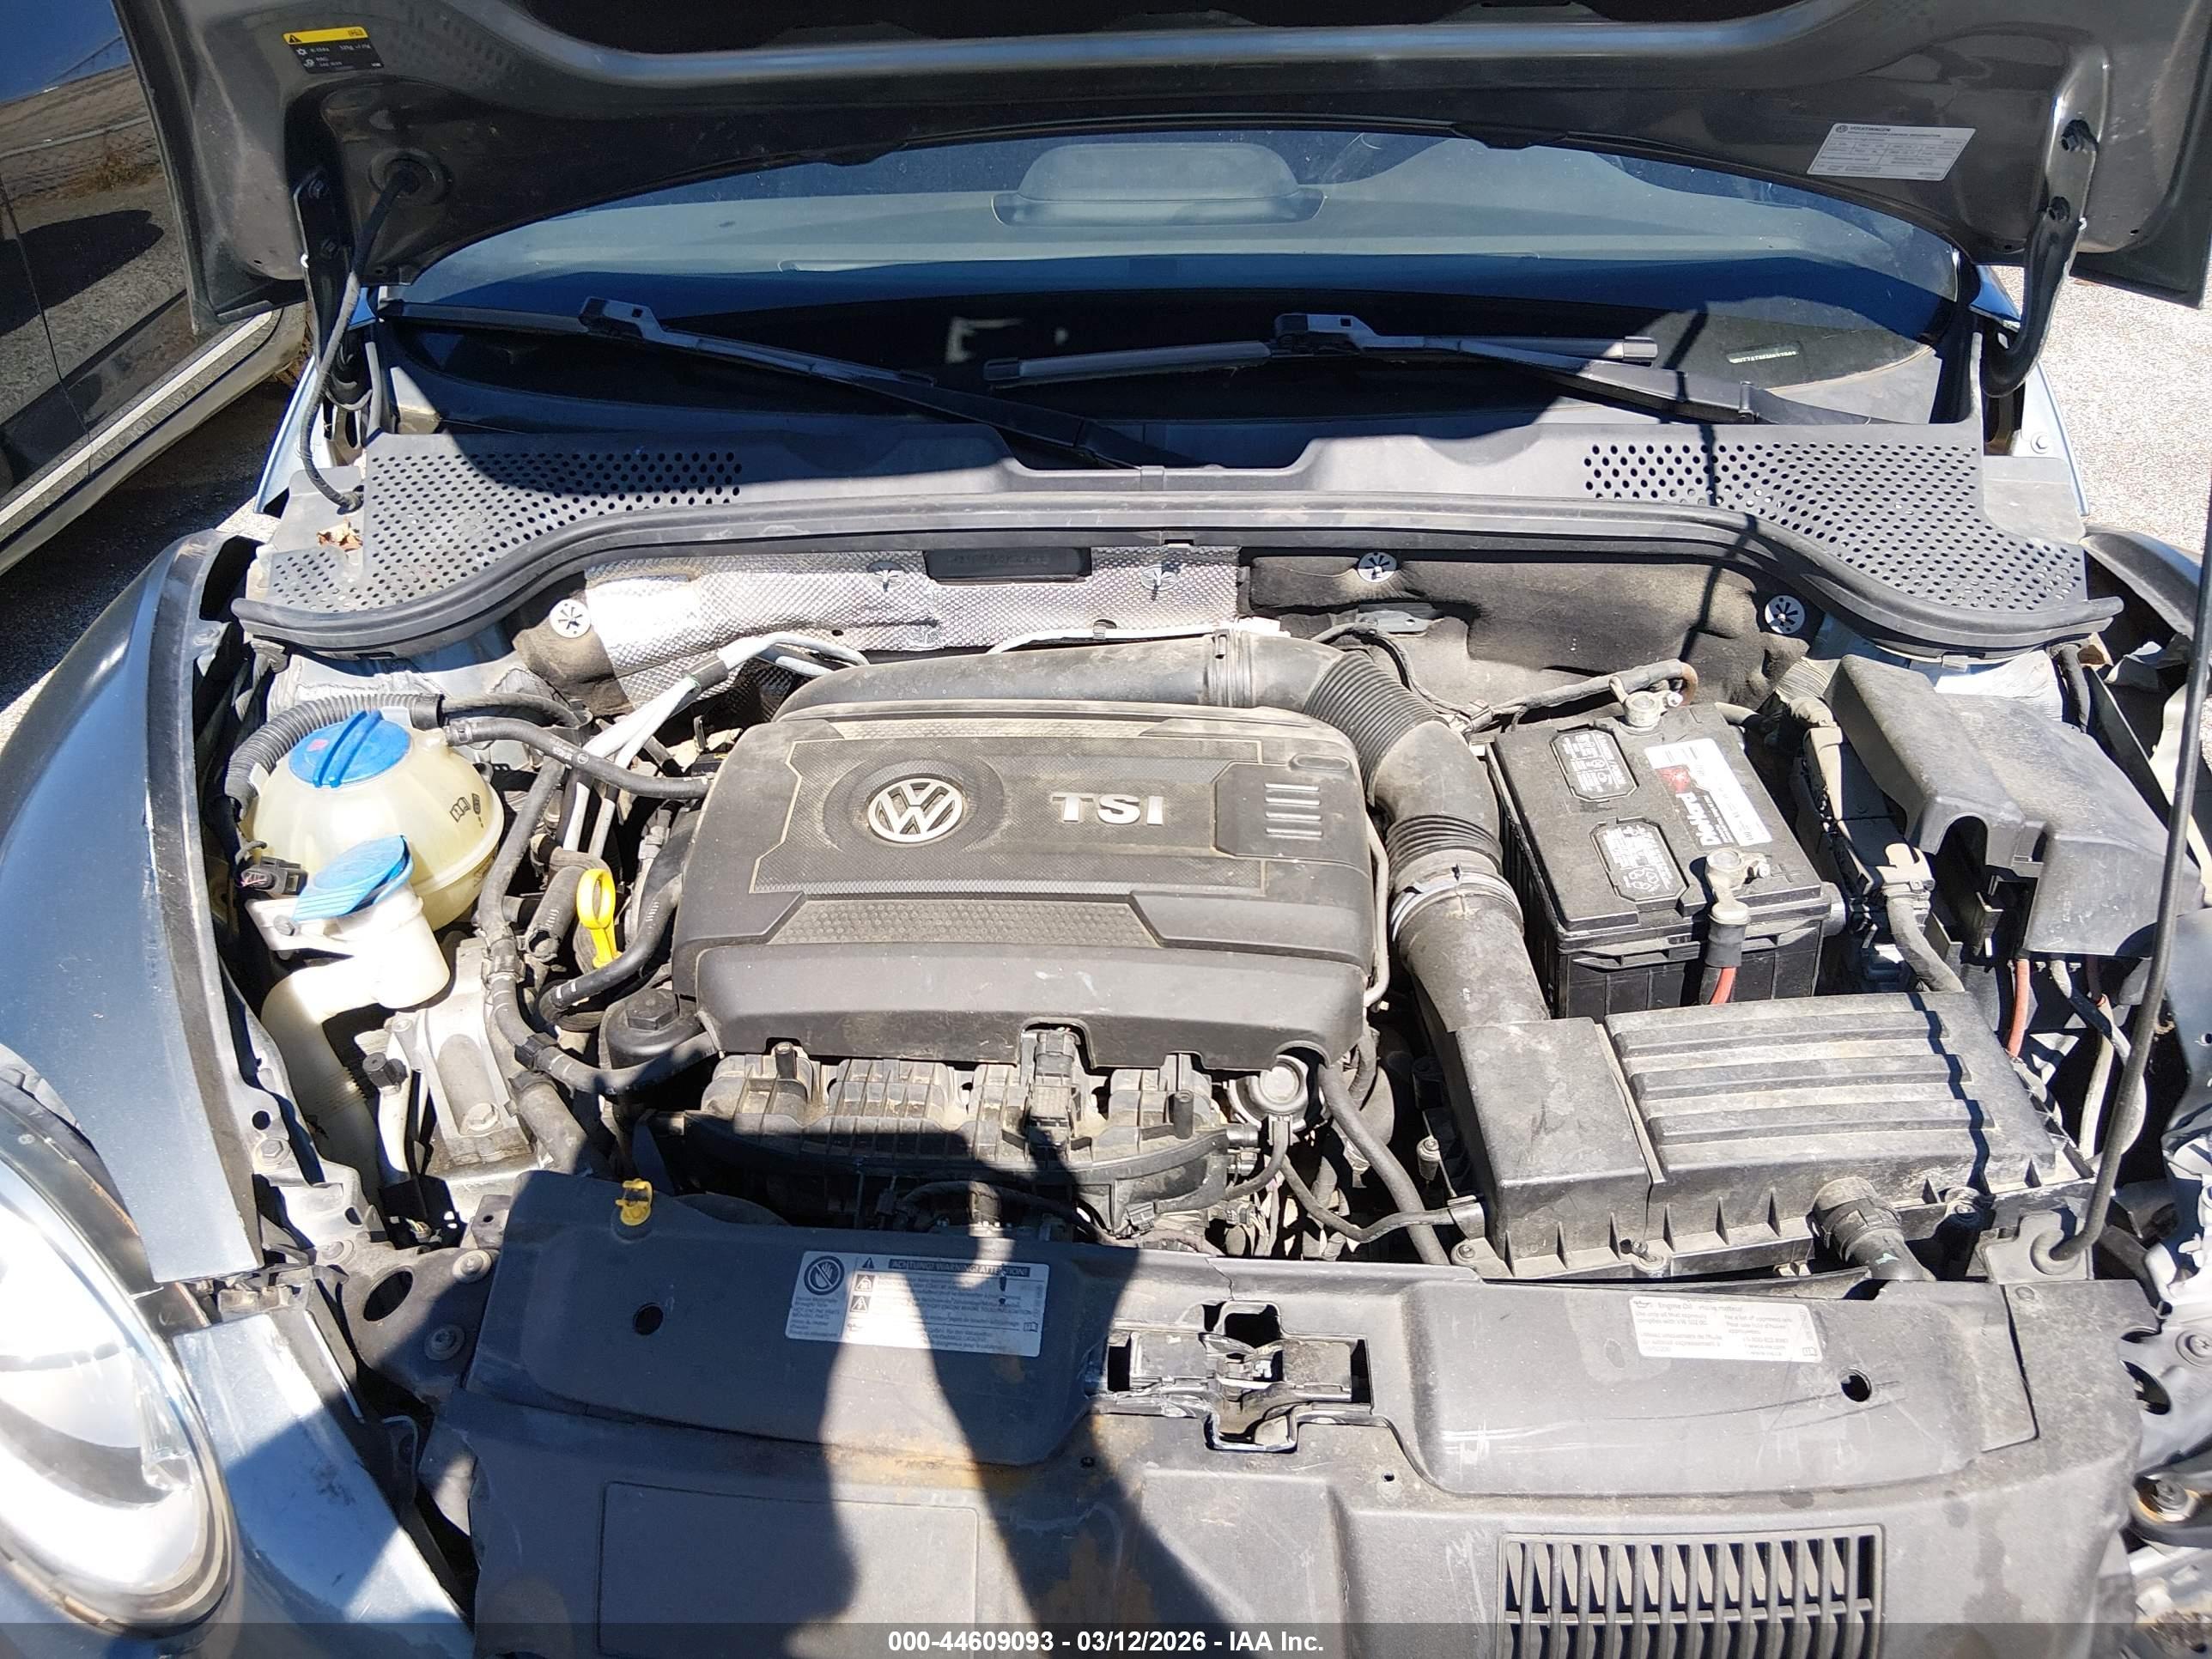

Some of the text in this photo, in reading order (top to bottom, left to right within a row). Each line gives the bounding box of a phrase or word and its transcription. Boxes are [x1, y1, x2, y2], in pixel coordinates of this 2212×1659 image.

[1050, 792, 1166, 826] TSI
[1675, 791, 1723, 846] DieHard
[892, 1261, 935, 1270] ACHTUNG!
[936, 1263, 979, 1273] WARNING!
[1657, 1302, 1681, 1310] Engine
